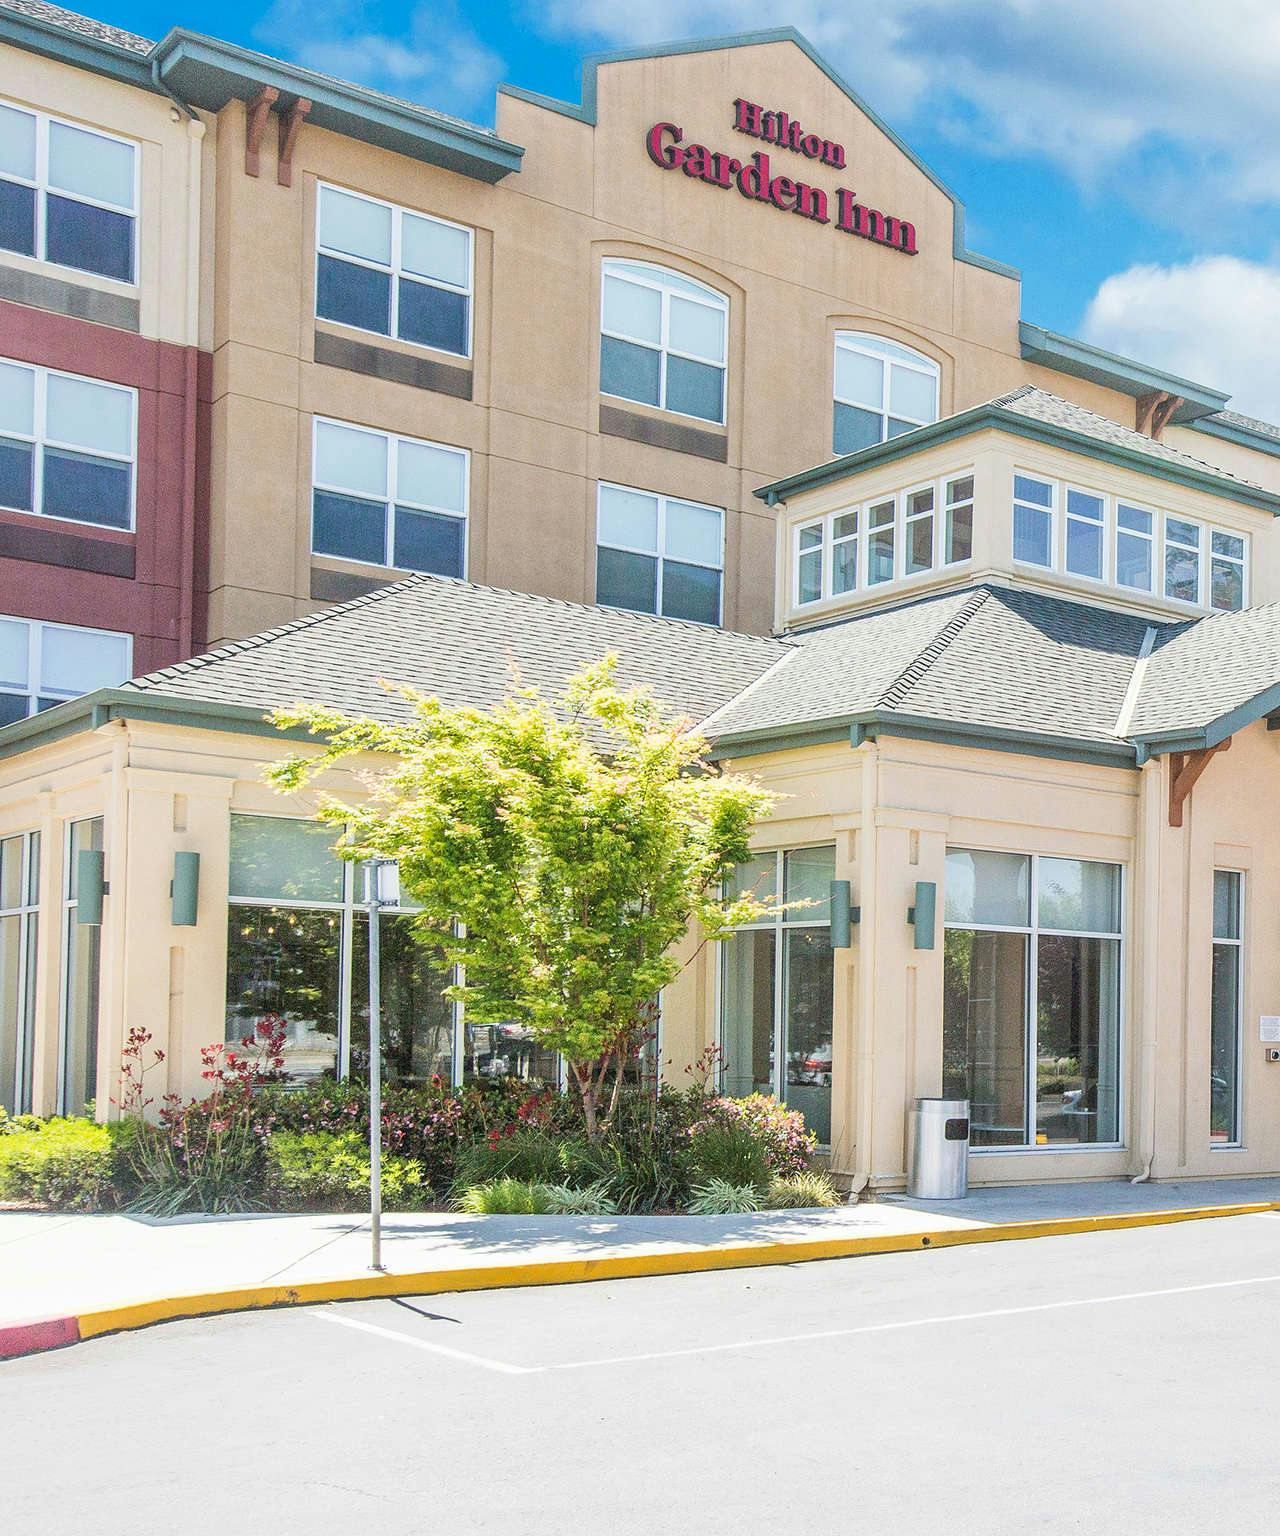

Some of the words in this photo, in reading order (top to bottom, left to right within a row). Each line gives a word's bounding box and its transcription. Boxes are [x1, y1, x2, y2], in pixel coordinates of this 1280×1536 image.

[732, 97, 847, 169] Hilton
[646, 122, 830, 224] Garden
[835, 187, 919, 256] Inn
